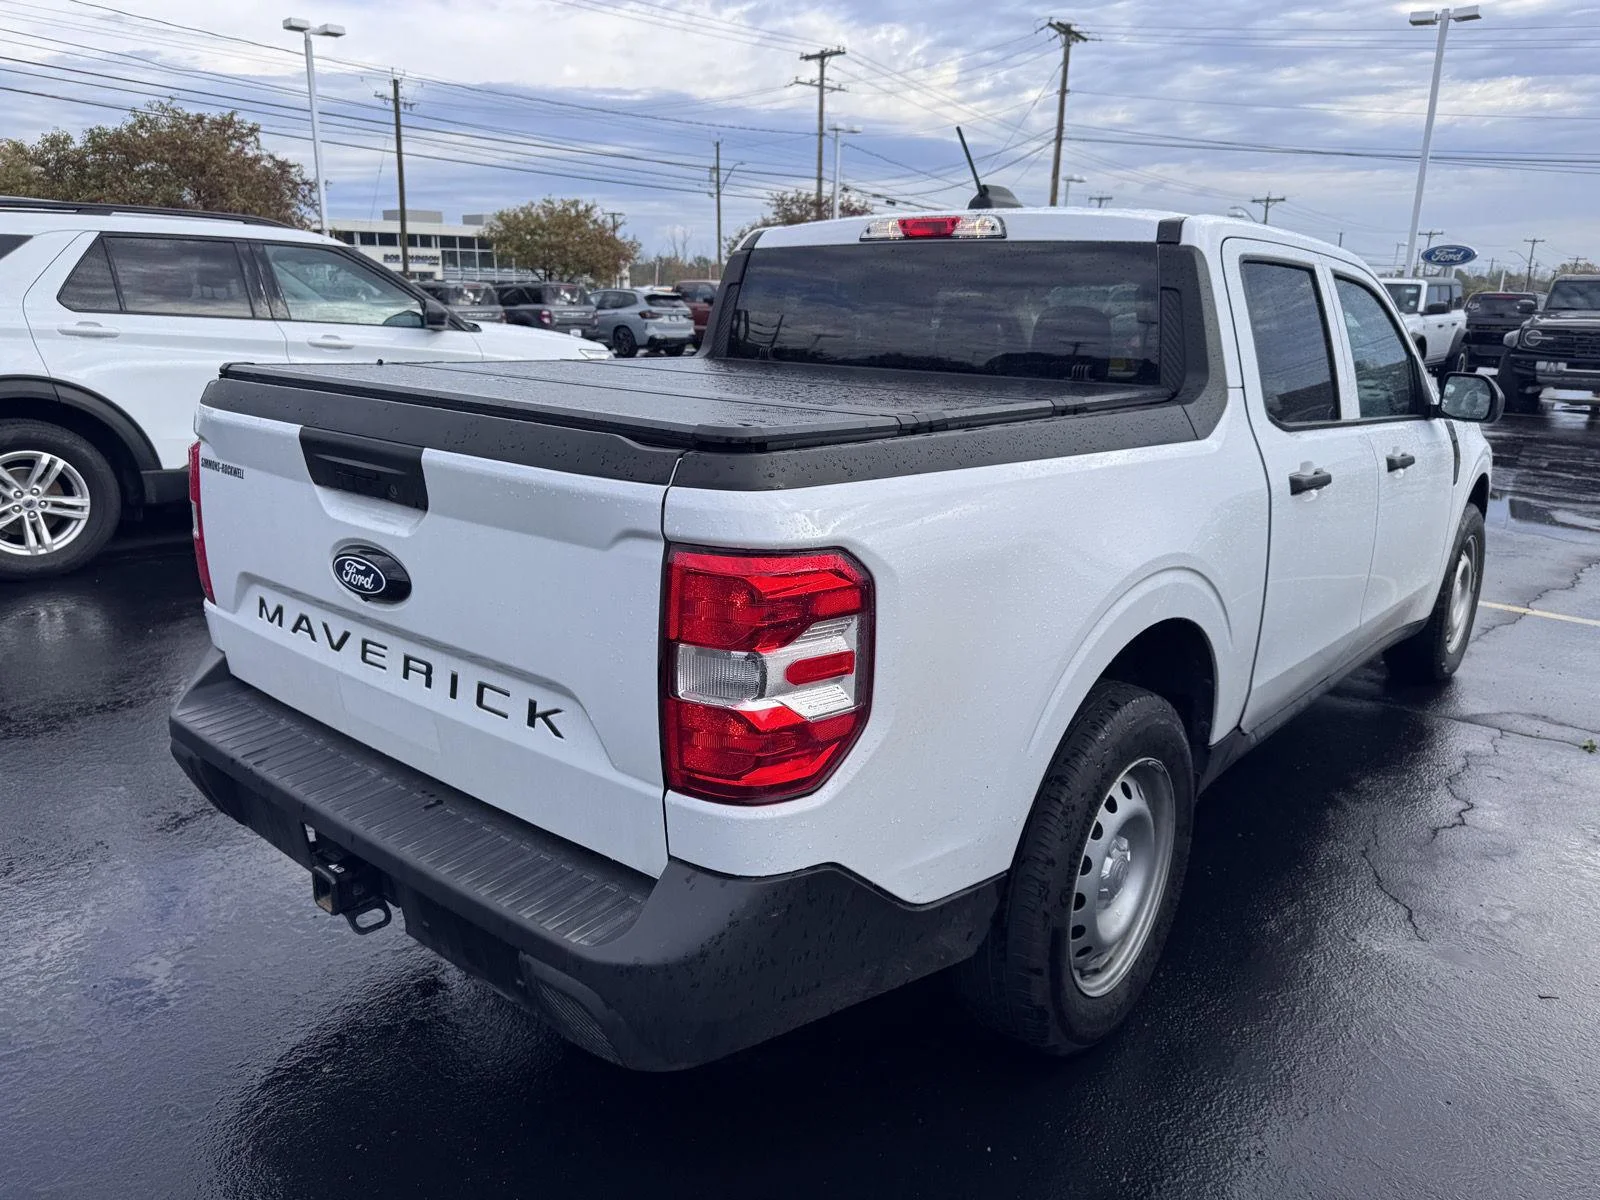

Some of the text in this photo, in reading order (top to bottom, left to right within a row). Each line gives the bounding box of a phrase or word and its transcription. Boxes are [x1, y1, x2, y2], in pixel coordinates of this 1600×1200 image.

[1431, 248, 1464, 261] Ford
[342, 560, 375, 590] Ford
[258, 596, 565, 740] MAVERICK
